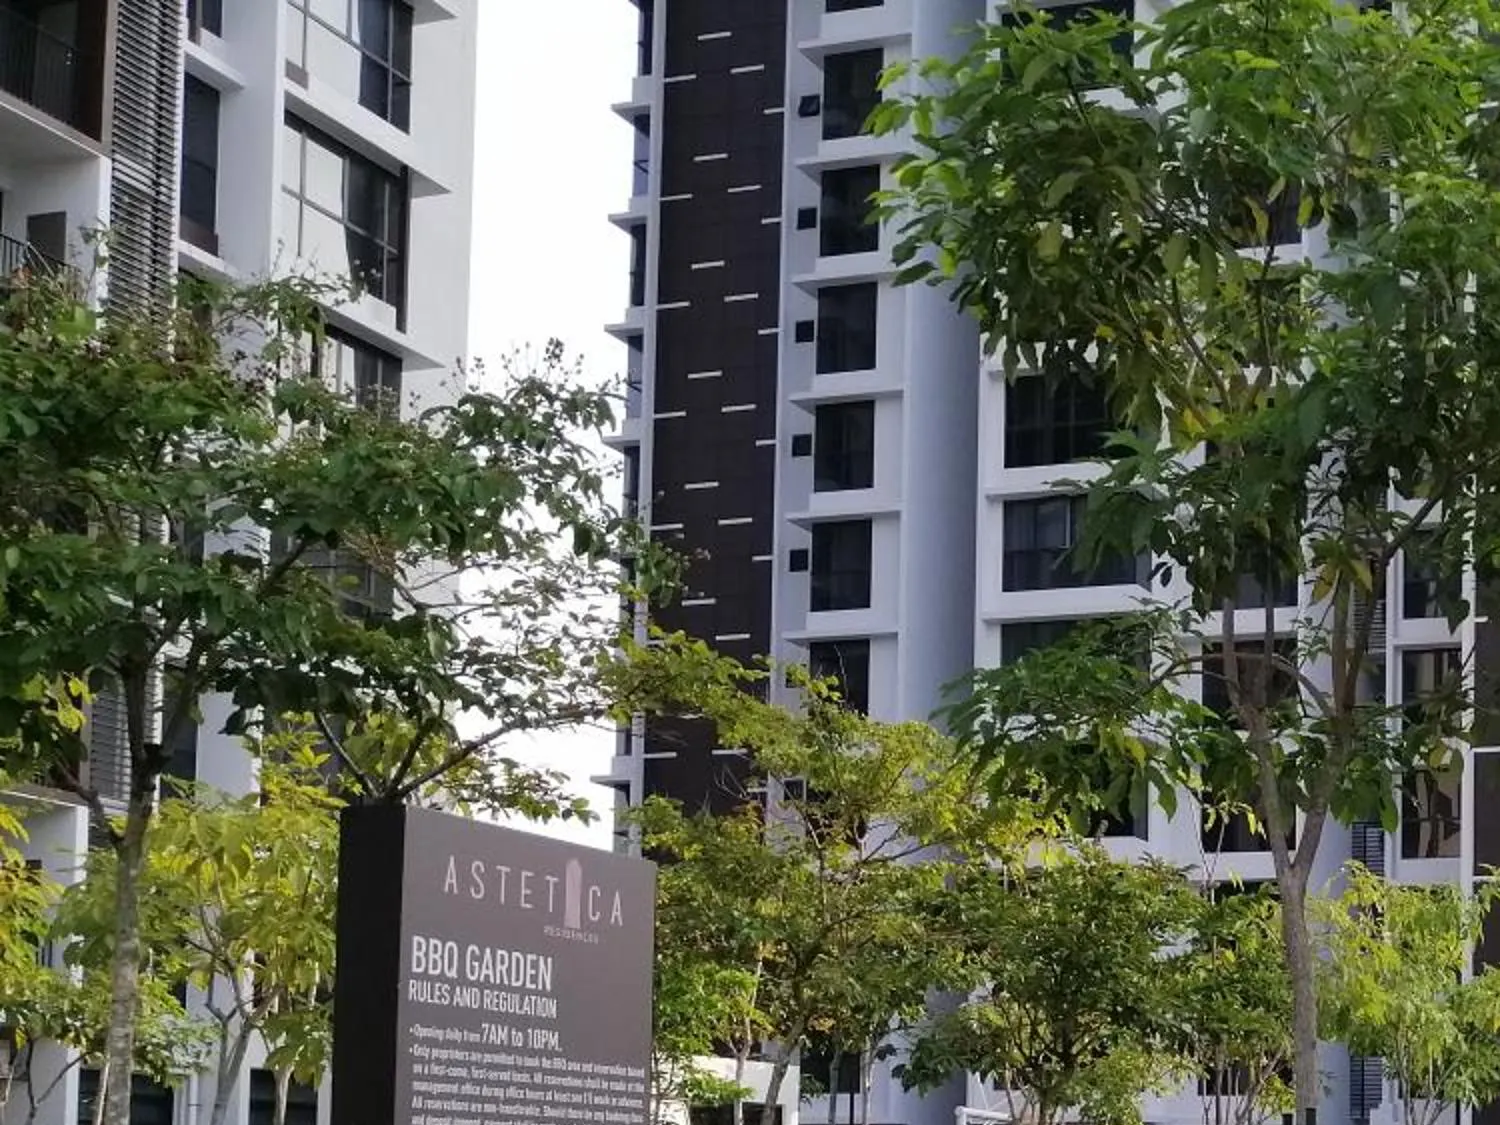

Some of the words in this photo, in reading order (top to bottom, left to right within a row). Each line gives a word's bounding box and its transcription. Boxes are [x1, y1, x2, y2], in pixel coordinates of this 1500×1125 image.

[411, 935, 458, 979] BBQ
[465, 944, 552, 991] GARDEN
[408, 979, 450, 1006] RULES
[453, 987, 480, 1010] AND
[483, 990, 557, 1019] REGULATION
[482, 1023, 508, 1046] 7AM
[511, 1029, 523, 1047] to
[527, 1028, 562, 1052] 10PM.
